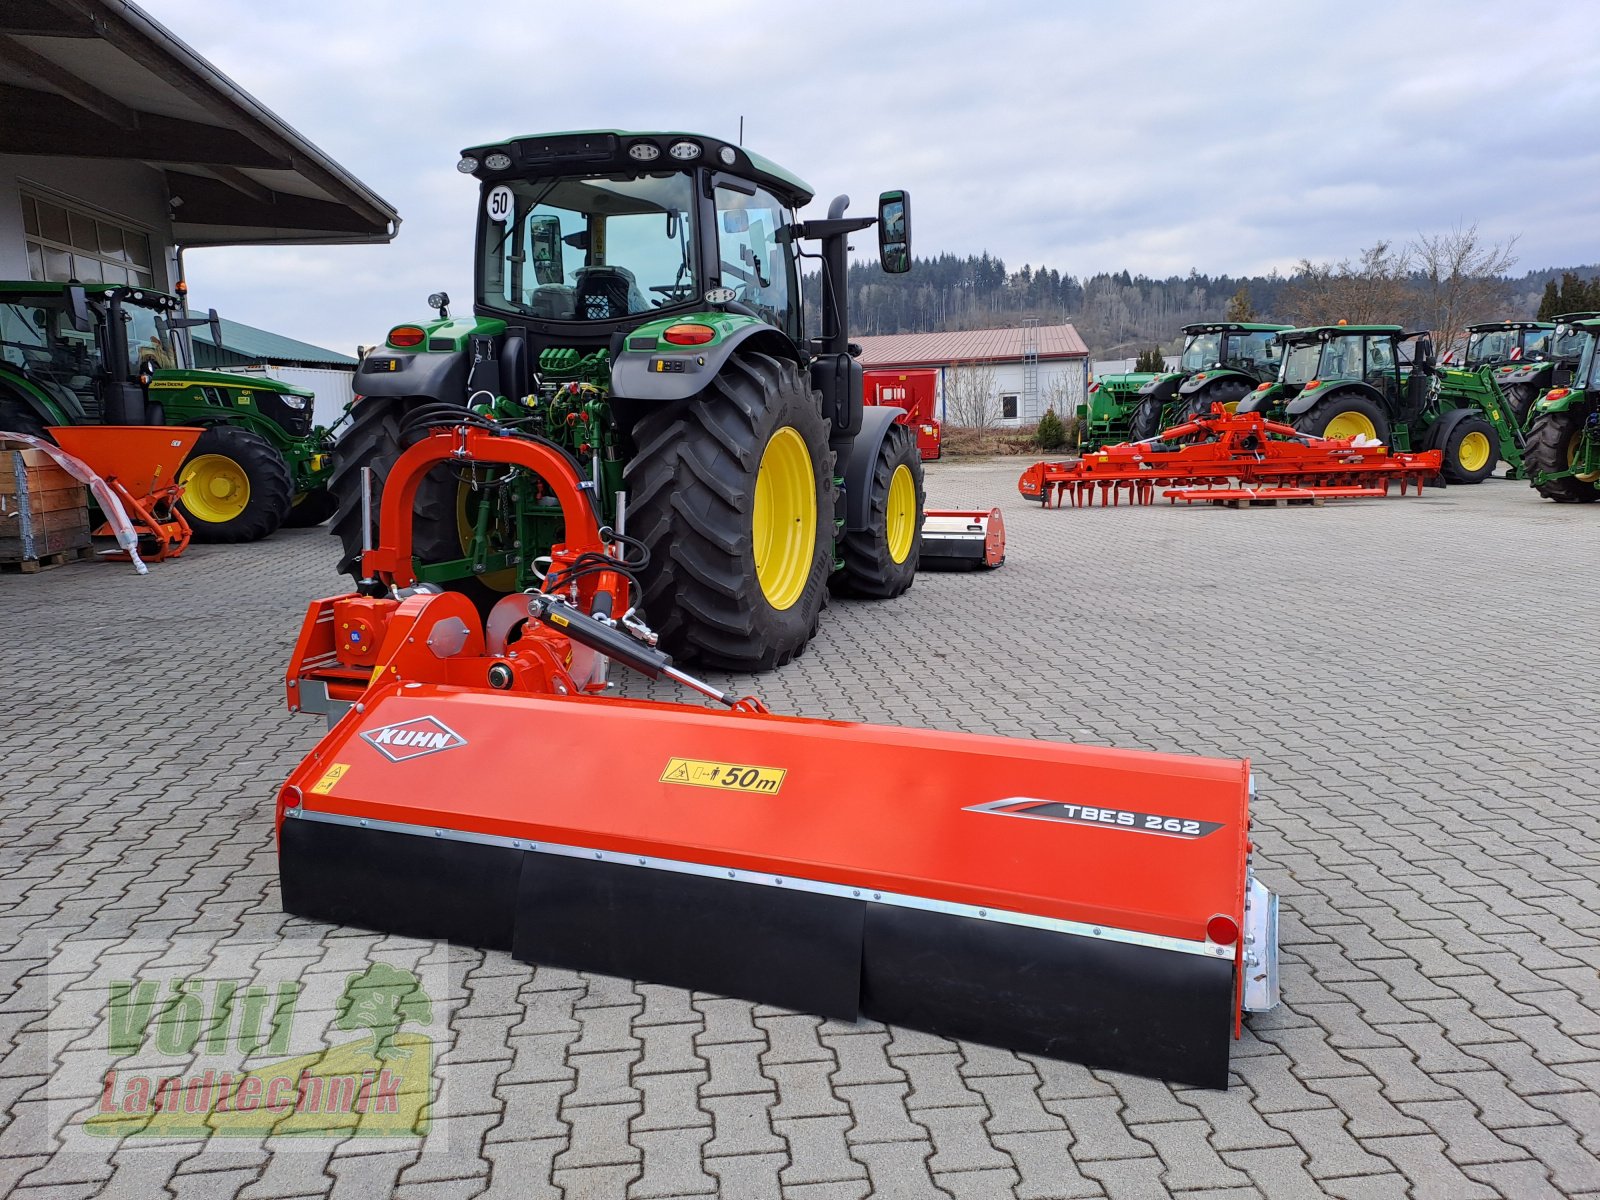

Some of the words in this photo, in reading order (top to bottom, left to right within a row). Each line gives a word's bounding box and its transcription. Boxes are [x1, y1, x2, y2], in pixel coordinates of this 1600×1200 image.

[492, 192, 508, 214] 50
[374, 728, 452, 748] KUHN
[1063, 804, 1135, 826] TBES
[1144, 816, 1200, 835] 262
